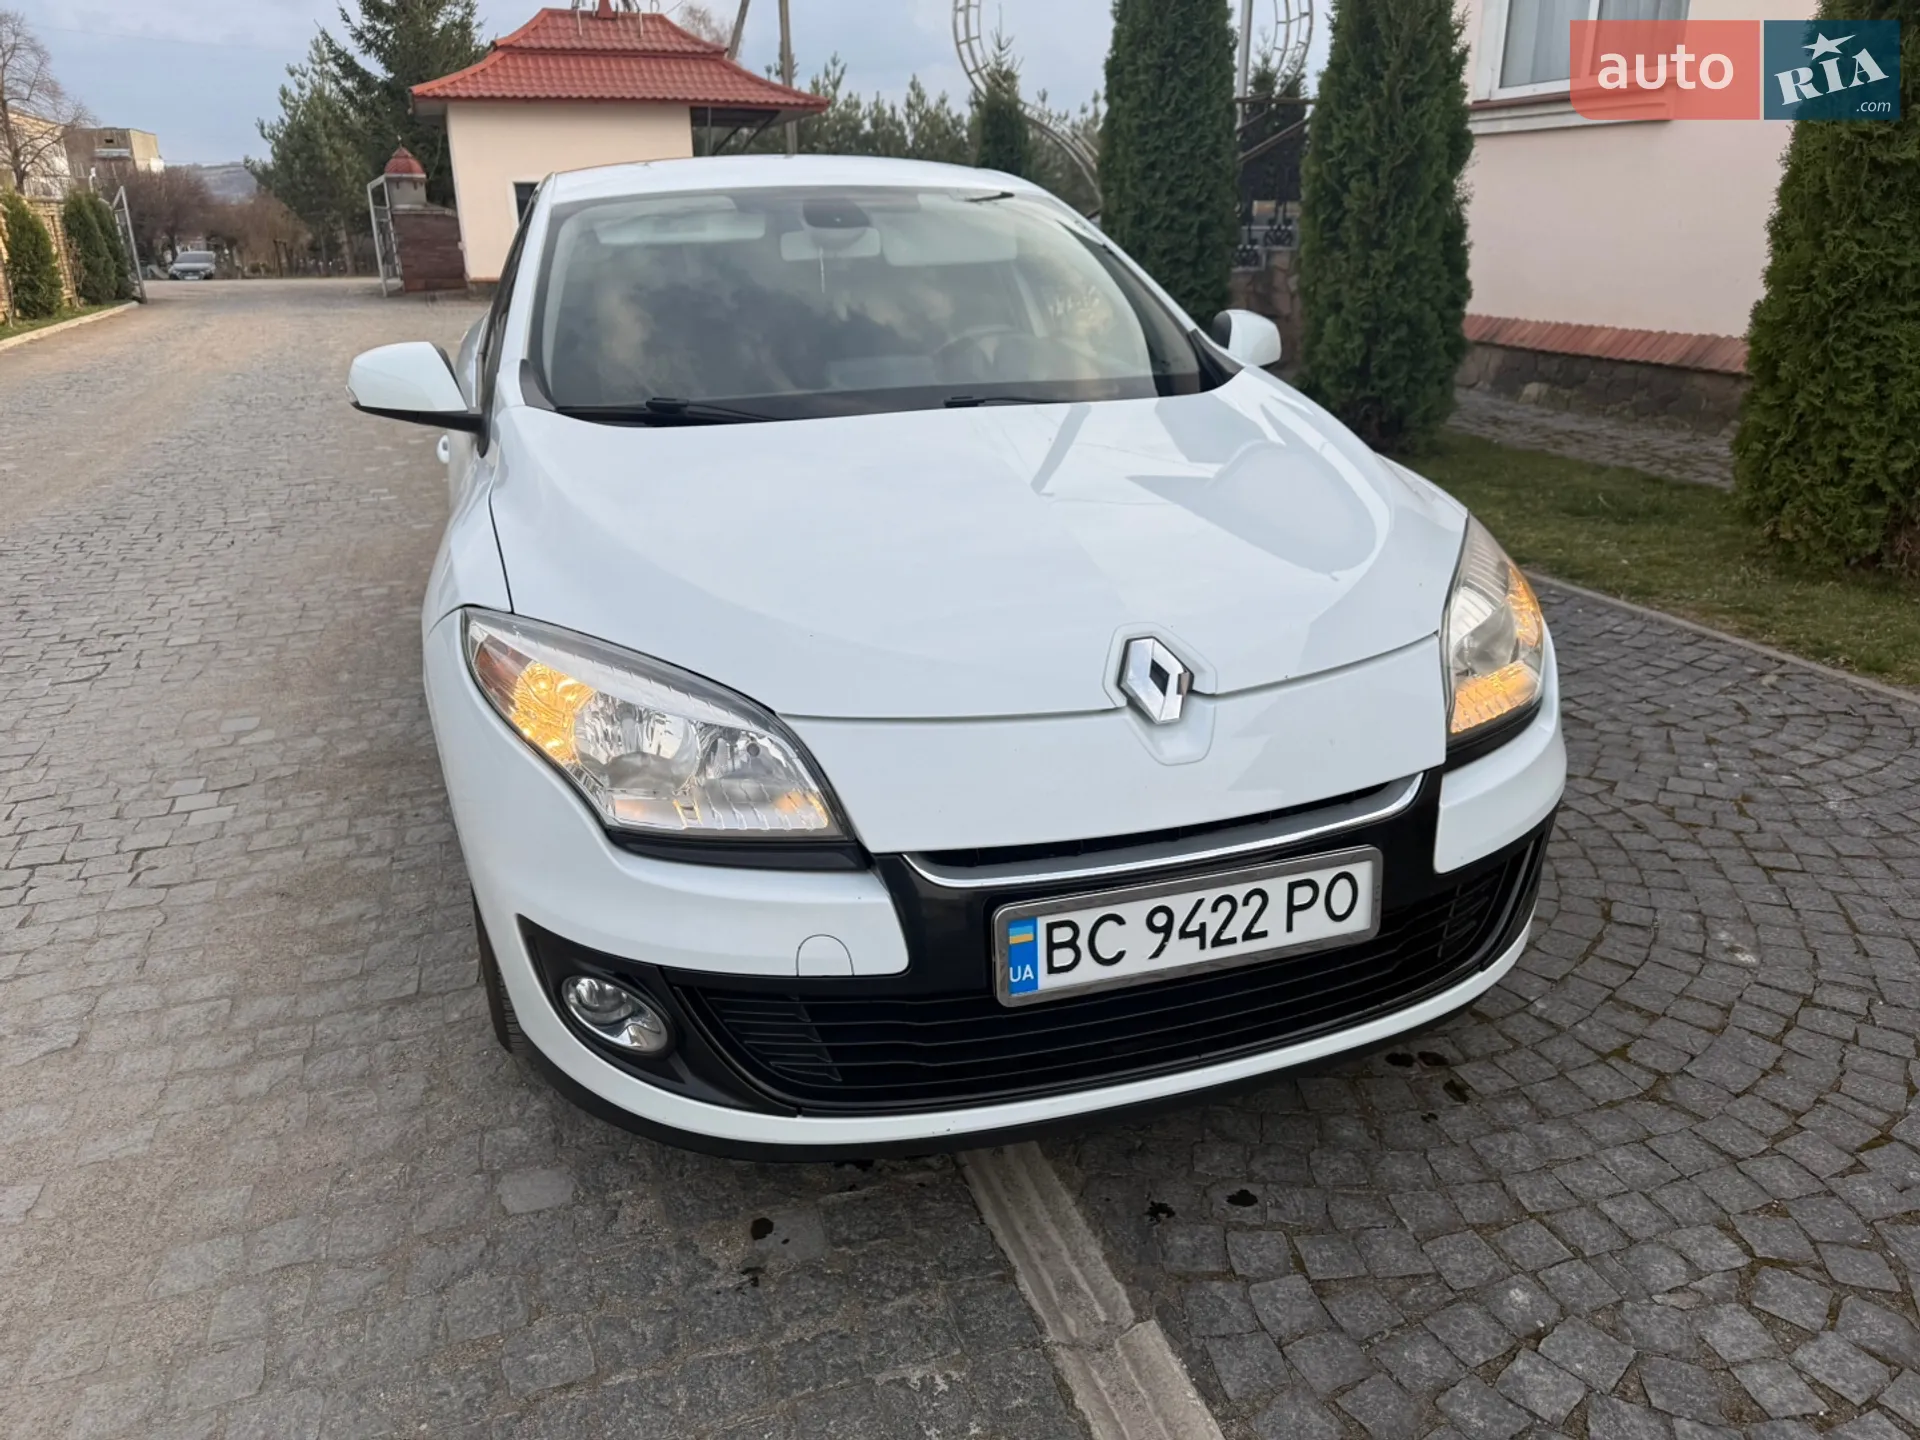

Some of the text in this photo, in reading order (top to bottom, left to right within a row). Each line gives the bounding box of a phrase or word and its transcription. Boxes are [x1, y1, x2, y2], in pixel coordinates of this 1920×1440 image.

[1045, 871, 1359, 975] BC 9422 PO
[1009, 964, 1034, 982] UA
